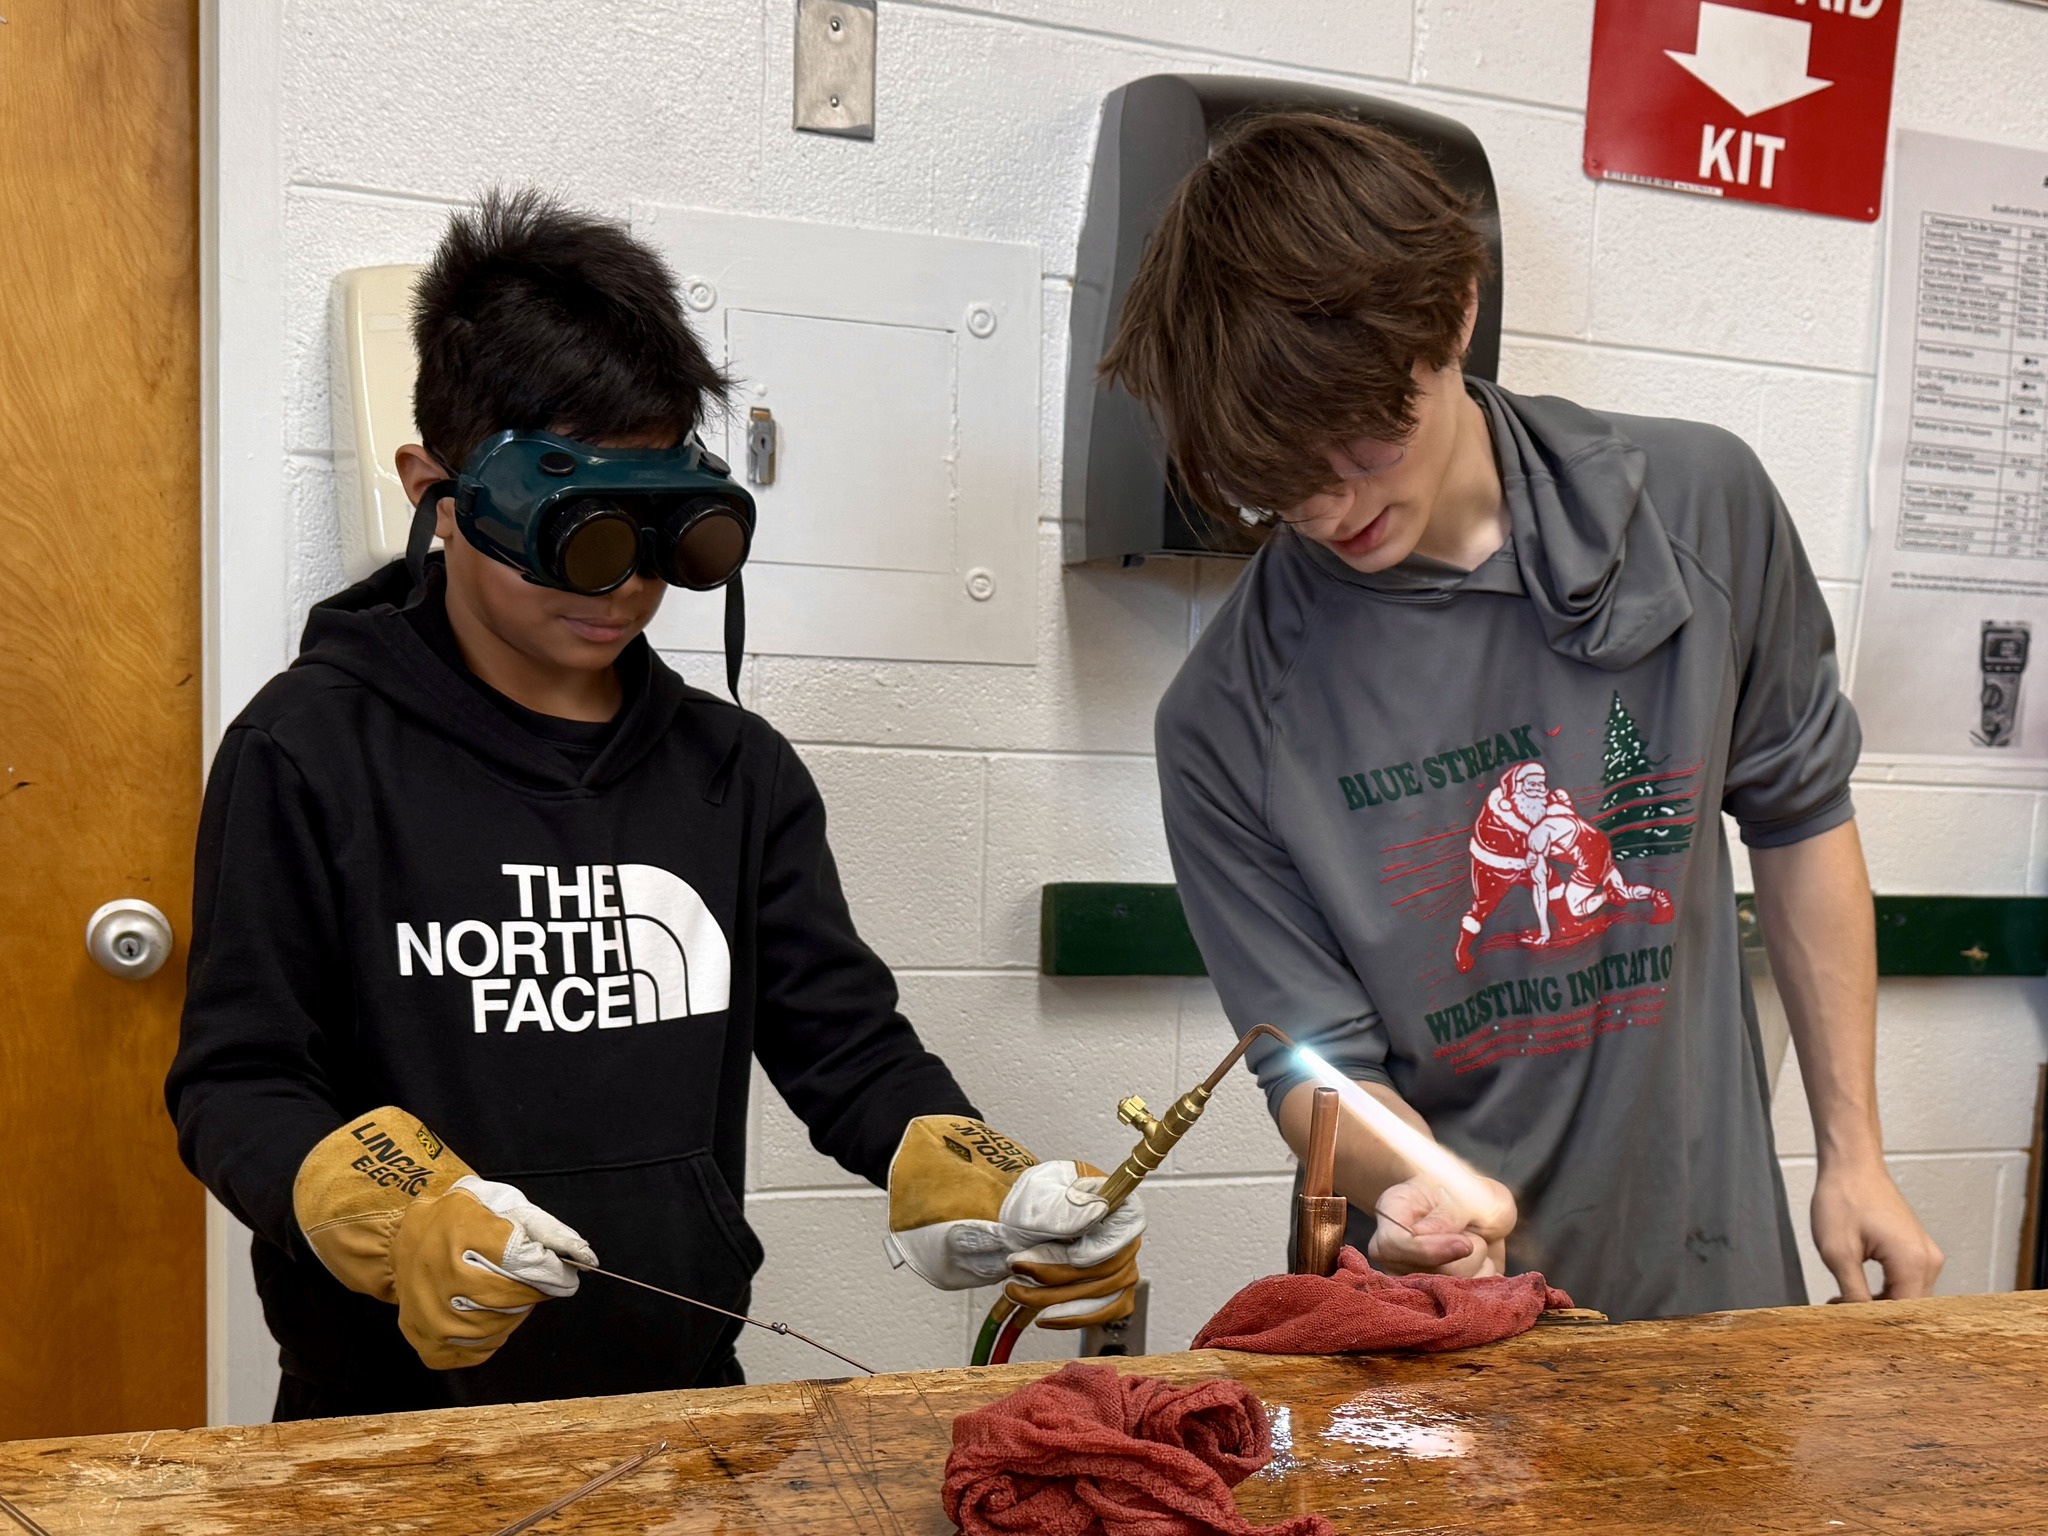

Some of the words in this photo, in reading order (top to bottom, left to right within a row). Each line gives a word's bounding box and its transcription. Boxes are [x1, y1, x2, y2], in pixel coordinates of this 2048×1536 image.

[1699, 124, 1786, 189] KIT
[1338, 761, 1424, 811] BLUE
[1423, 724, 1542, 789] STREAK
[501, 863, 620, 919] THE
[396, 919, 628, 977] NORTH
[471, 974, 633, 1034] FACE
[1424, 976, 1563, 1045] WRESTLING
[1566, 943, 1674, 1006] INVITATIO
